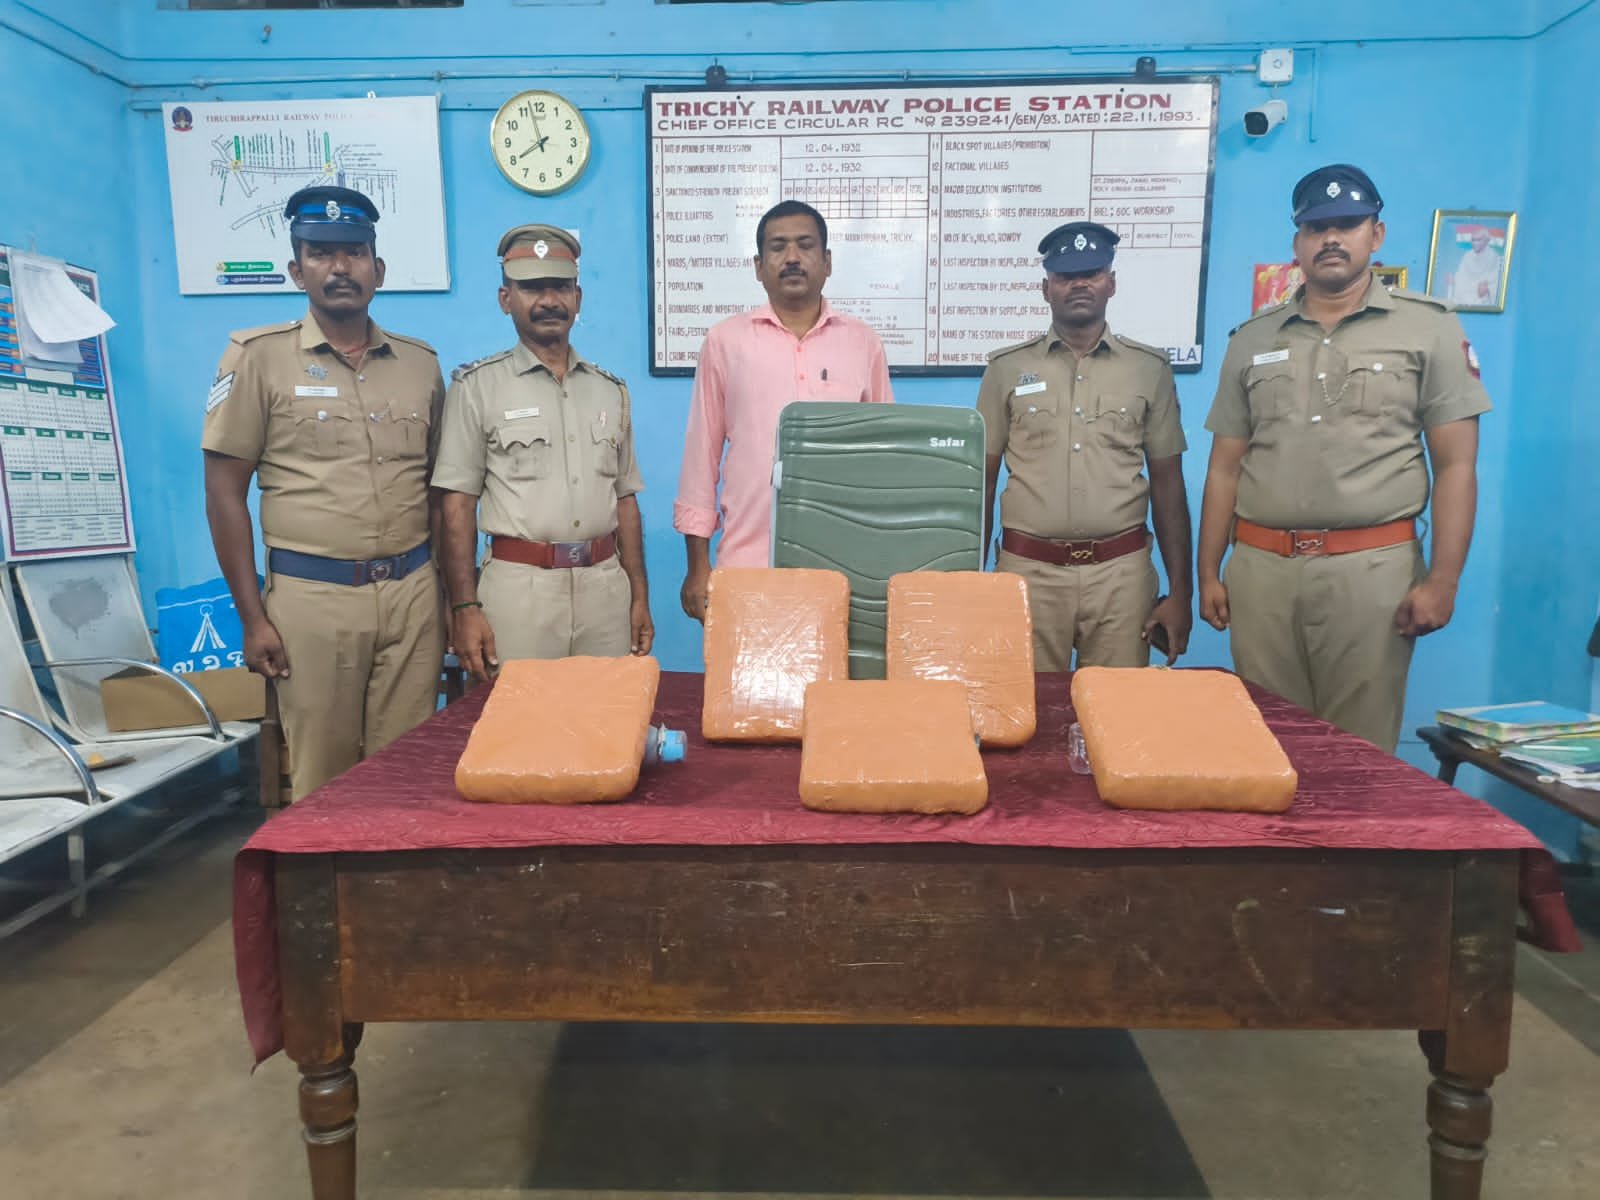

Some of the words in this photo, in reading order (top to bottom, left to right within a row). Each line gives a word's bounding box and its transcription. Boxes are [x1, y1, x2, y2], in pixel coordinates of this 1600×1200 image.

[534, 102, 545, 113] 12
[656, 101, 755, 117] TRICHY
[767, 99, 890, 116] RAILWAY
[903, 97, 1011, 113] POLICE
[1028, 93, 1172, 111] STATION
[519, 107, 529, 118] 11
[554, 107, 559, 118] 1
[506, 120, 518, 131] 10
[565, 120, 572, 131] 2
[657, 119, 708, 130] CHIEF
[713, 118, 777, 130] OFFICE
[784, 117, 869, 129] CIRCULAR
[876, 116, 905, 127] RC
[505, 137, 512, 148] 9
[570, 137, 577, 148] 3
[510, 155, 517, 166] 8
[566, 155, 573, 165] 4
[522, 168, 529, 178] 7
[539, 172, 546, 183] 6
[556, 168, 562, 178] 5
